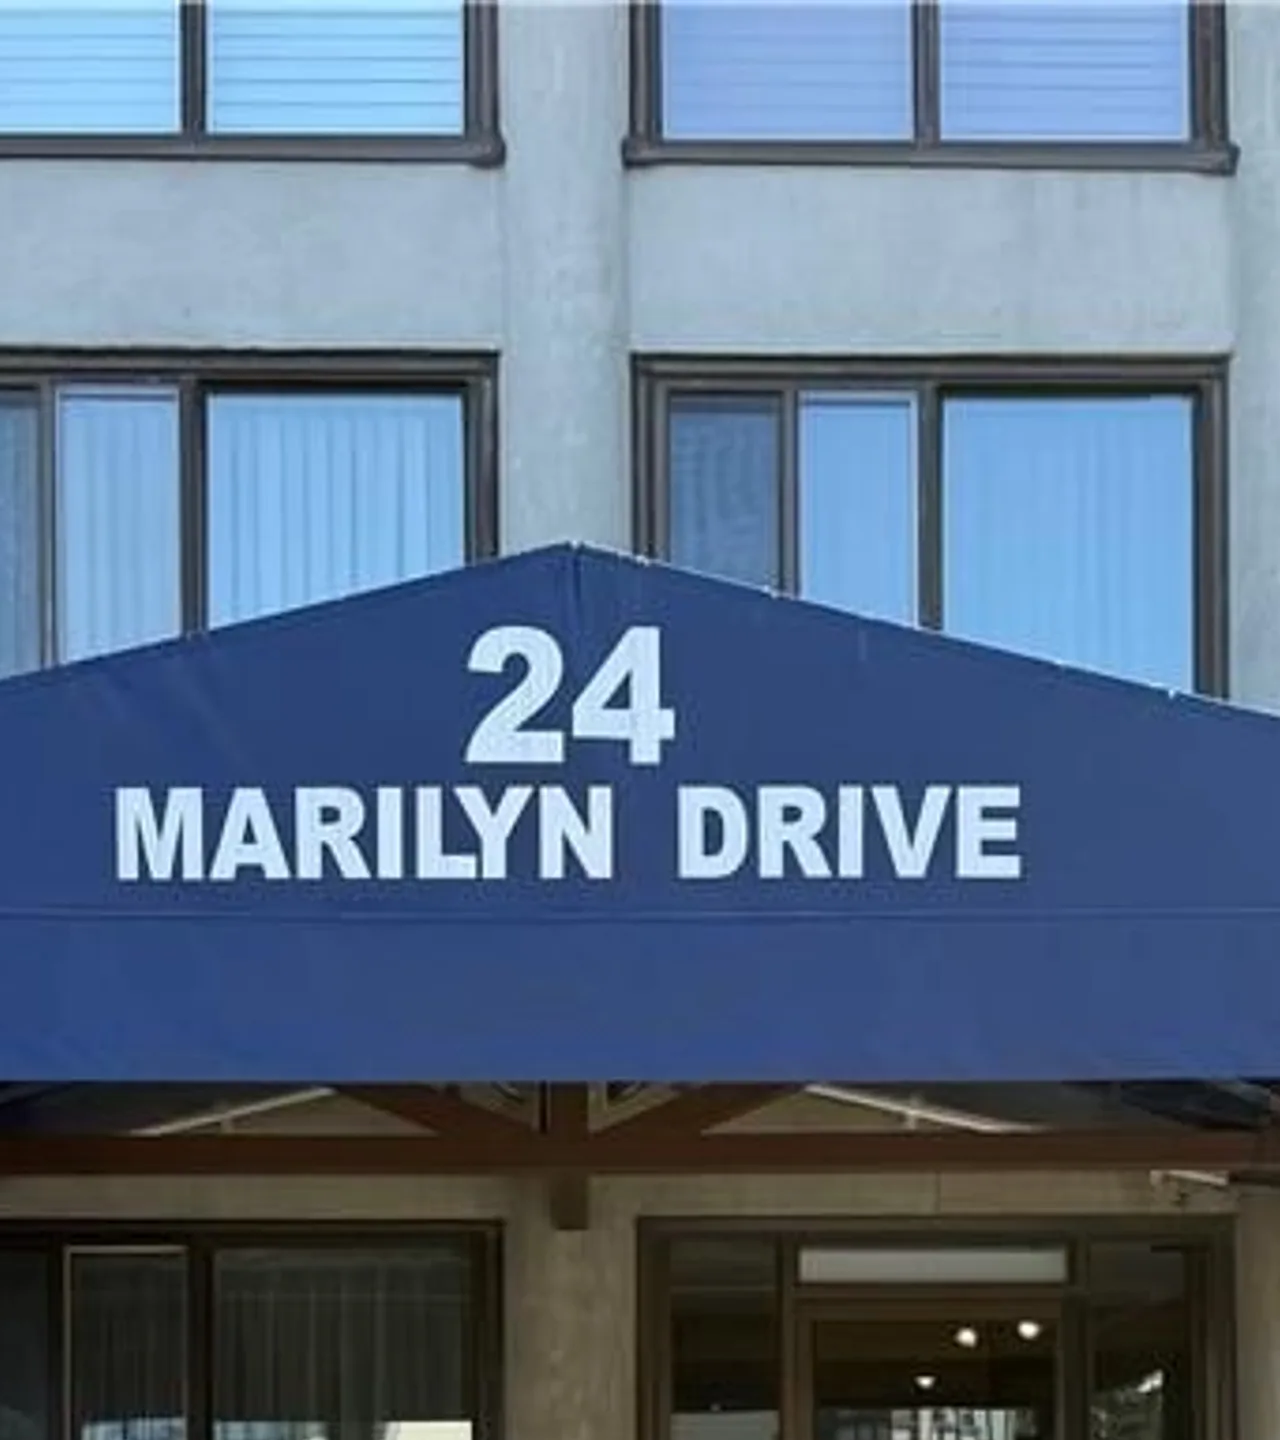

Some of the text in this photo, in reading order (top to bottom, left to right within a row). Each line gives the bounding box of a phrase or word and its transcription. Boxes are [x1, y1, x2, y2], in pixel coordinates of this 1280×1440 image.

[464, 625, 676, 766] 24
[116, 786, 1023, 880] MARILYN DRIVE
